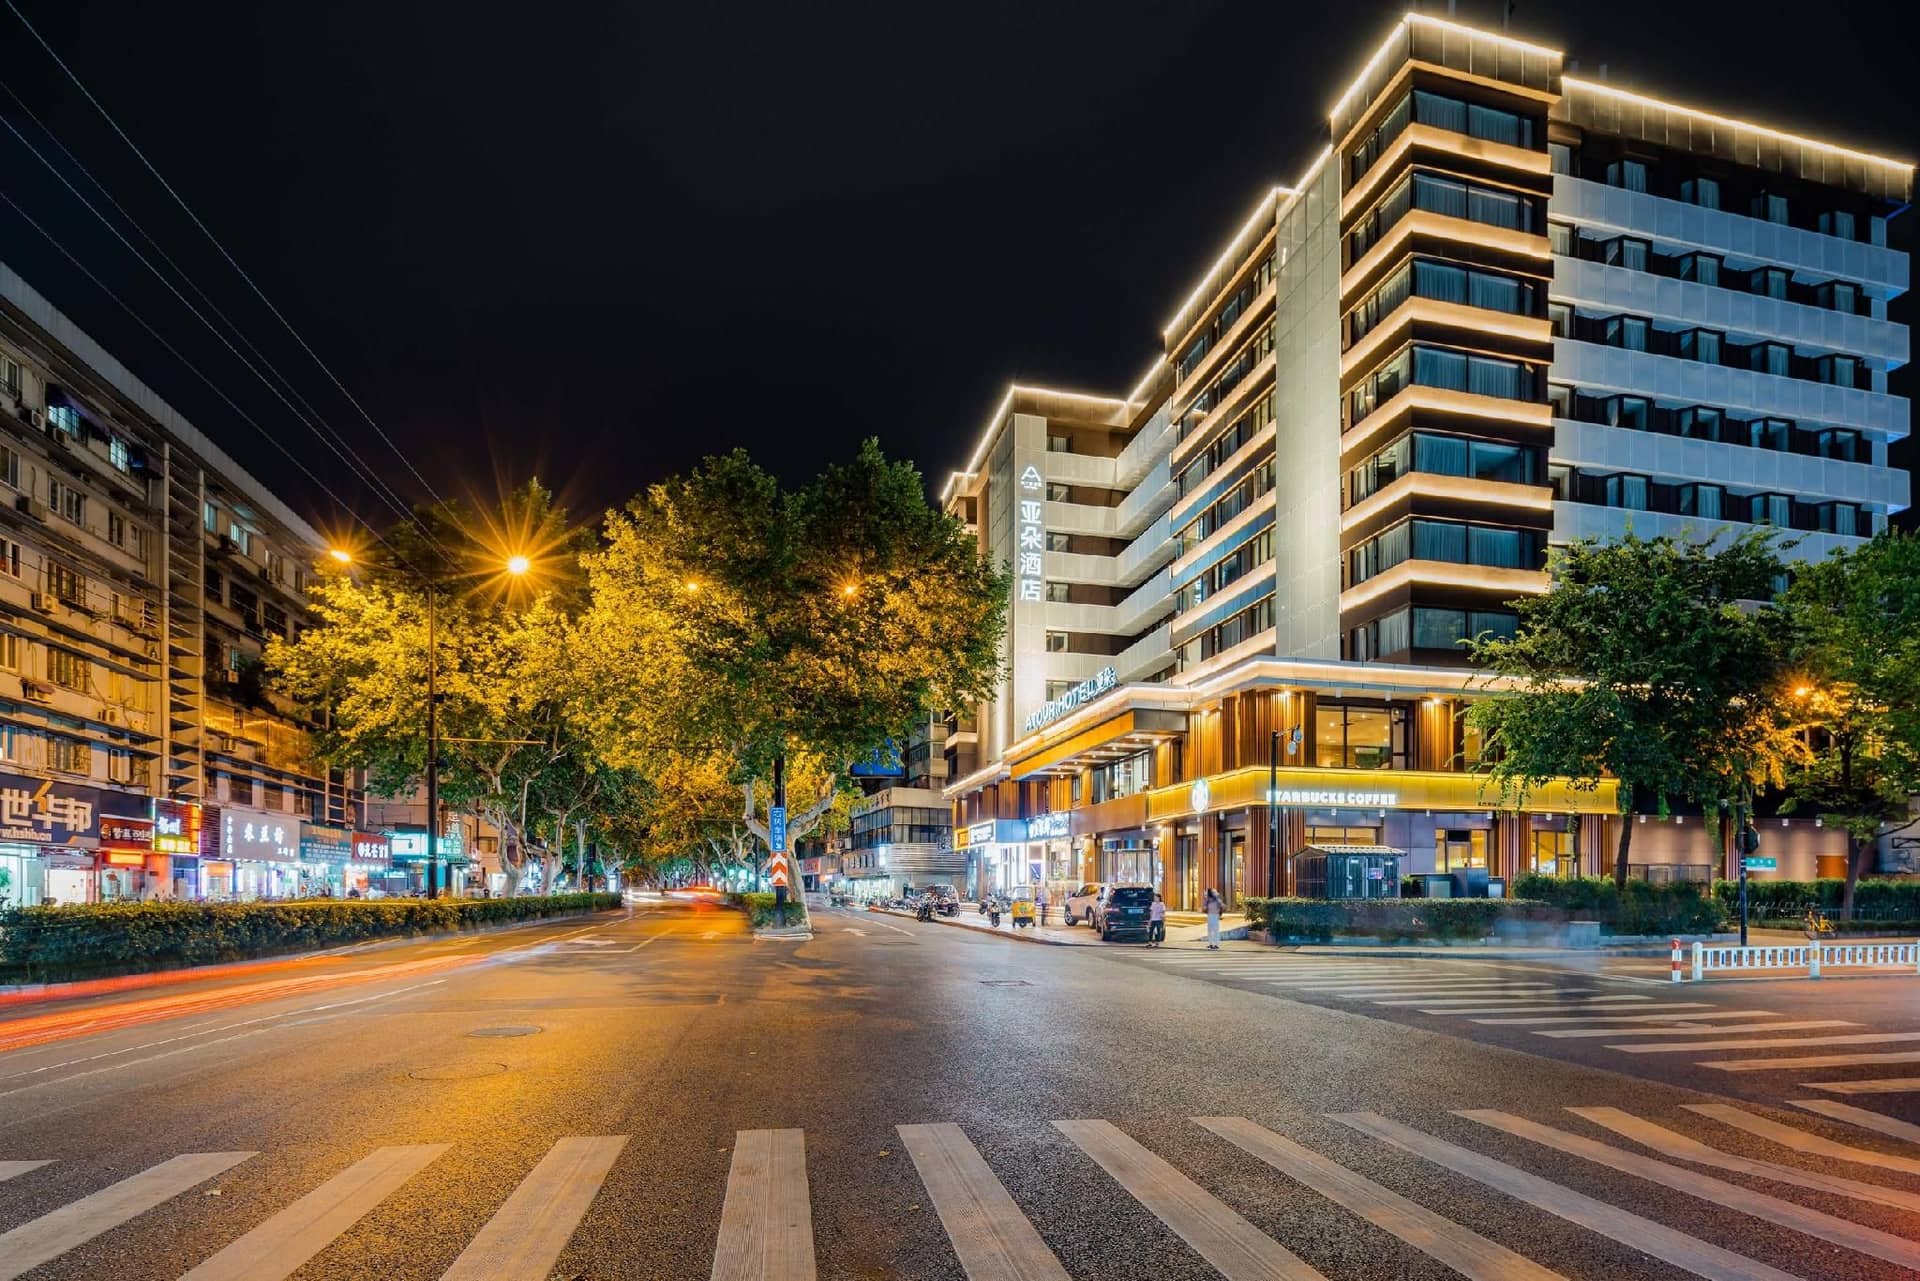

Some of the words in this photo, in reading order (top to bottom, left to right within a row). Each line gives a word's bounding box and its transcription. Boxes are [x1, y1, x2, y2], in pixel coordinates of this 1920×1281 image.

[1020, 501, 1042, 601] 亚朵酒店
[1347, 793, 1396, 805] COFFEE
